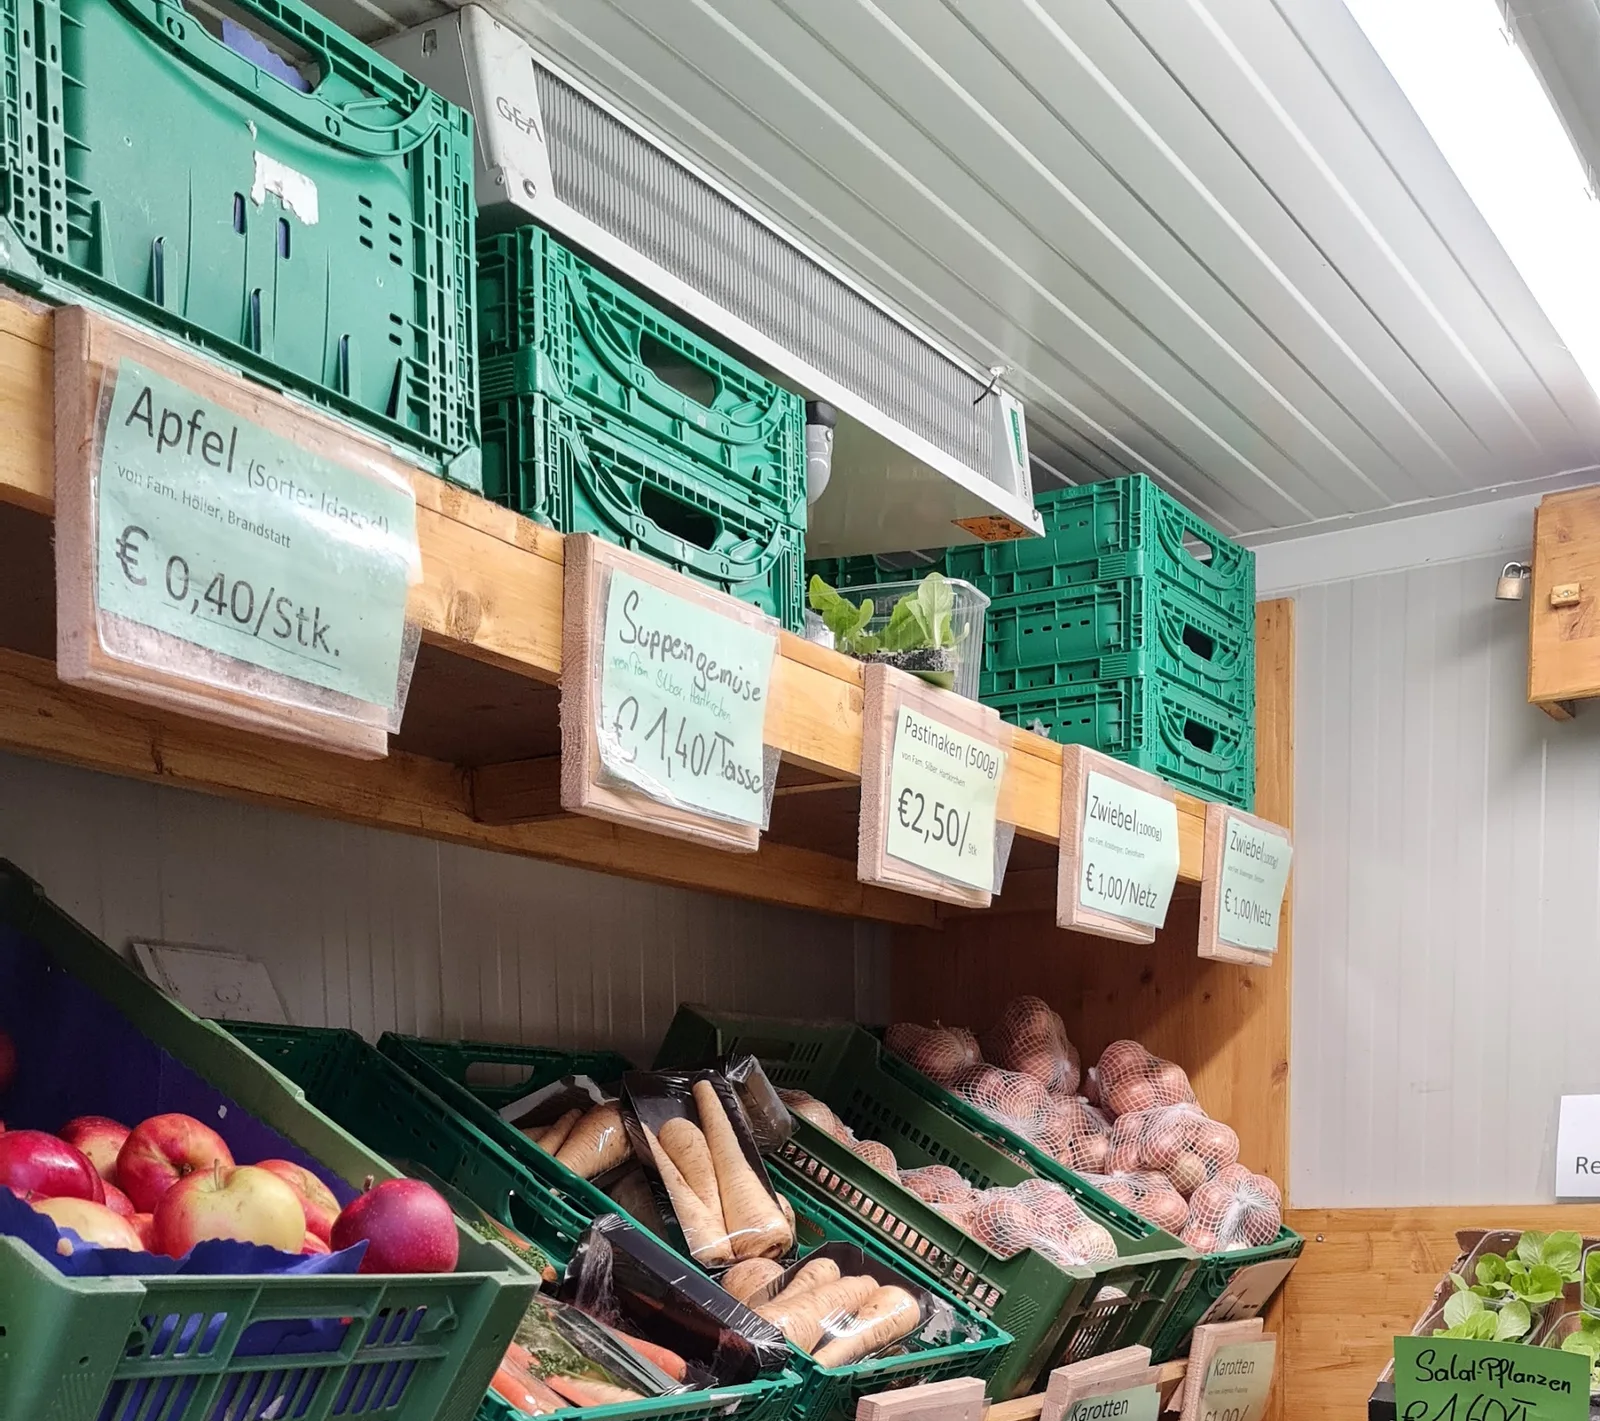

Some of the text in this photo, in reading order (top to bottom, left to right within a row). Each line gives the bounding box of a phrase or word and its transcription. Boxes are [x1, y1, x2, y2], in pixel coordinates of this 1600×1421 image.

[496, 96, 543, 143] GEA
[125, 387, 237, 474] Apfel
[247, 459, 313, 509] (Sorte:
[117, 465, 142, 487] von
[147, 476, 177, 501] Fam.
[228, 510, 291, 549] Brandstatt
[115, 525, 340, 657] € 0,40/Stk.
[619, 590, 761, 701] Suppengemüse
[904, 715, 999, 780] Pastinaken (500g)
[1098, 873, 1157, 910] 1,00/Netz
[1233, 895, 1272, 927] 1,00/Netz
[1213, 1358, 1255, 1377] Karotten
